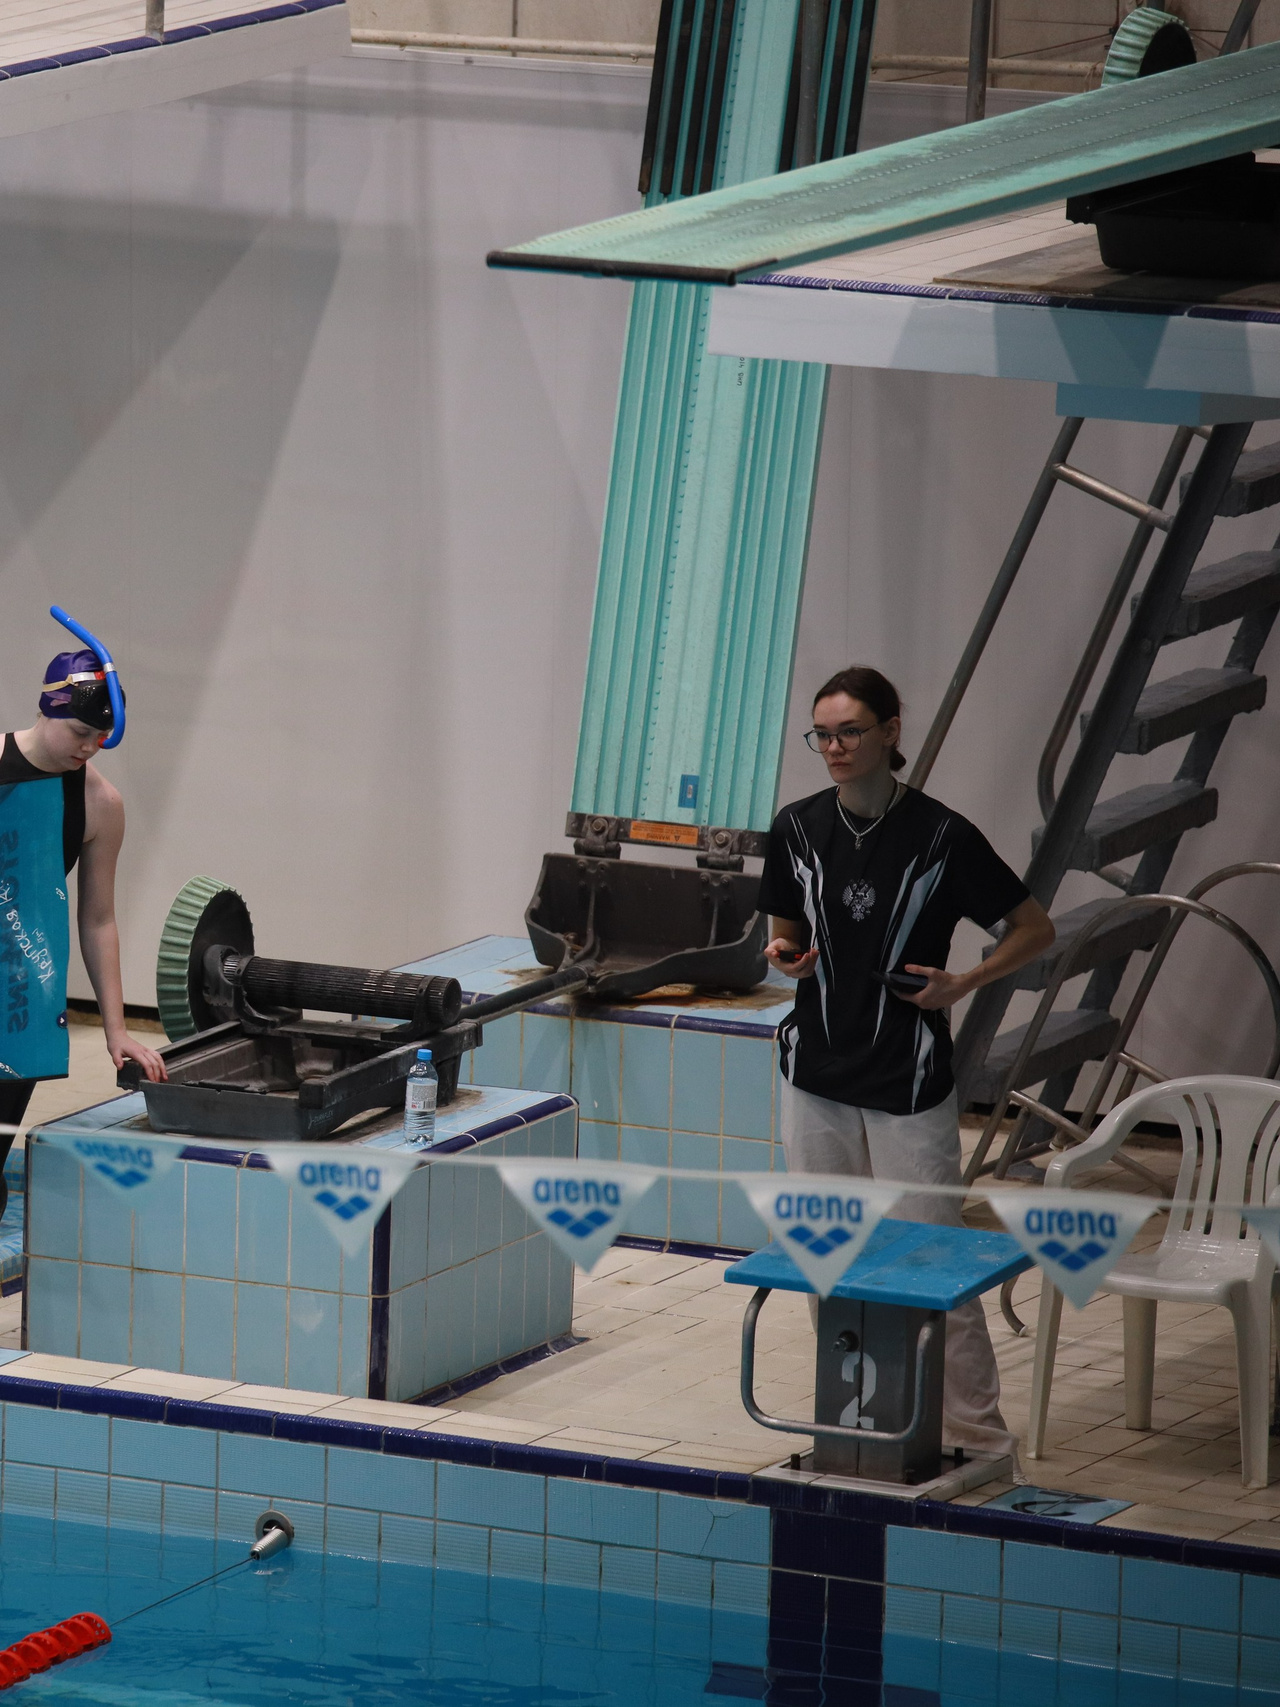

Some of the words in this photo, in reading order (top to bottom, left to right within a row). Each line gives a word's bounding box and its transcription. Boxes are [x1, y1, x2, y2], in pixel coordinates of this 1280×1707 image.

[299, 1163, 381, 1191] arena
[533, 1179, 621, 1206] arena
[775, 1194, 864, 1223] arena
[1025, 1208, 1117, 1238] arena
[839, 1352, 877, 1430] 2
[1010, 1490, 1108, 1517] 2
